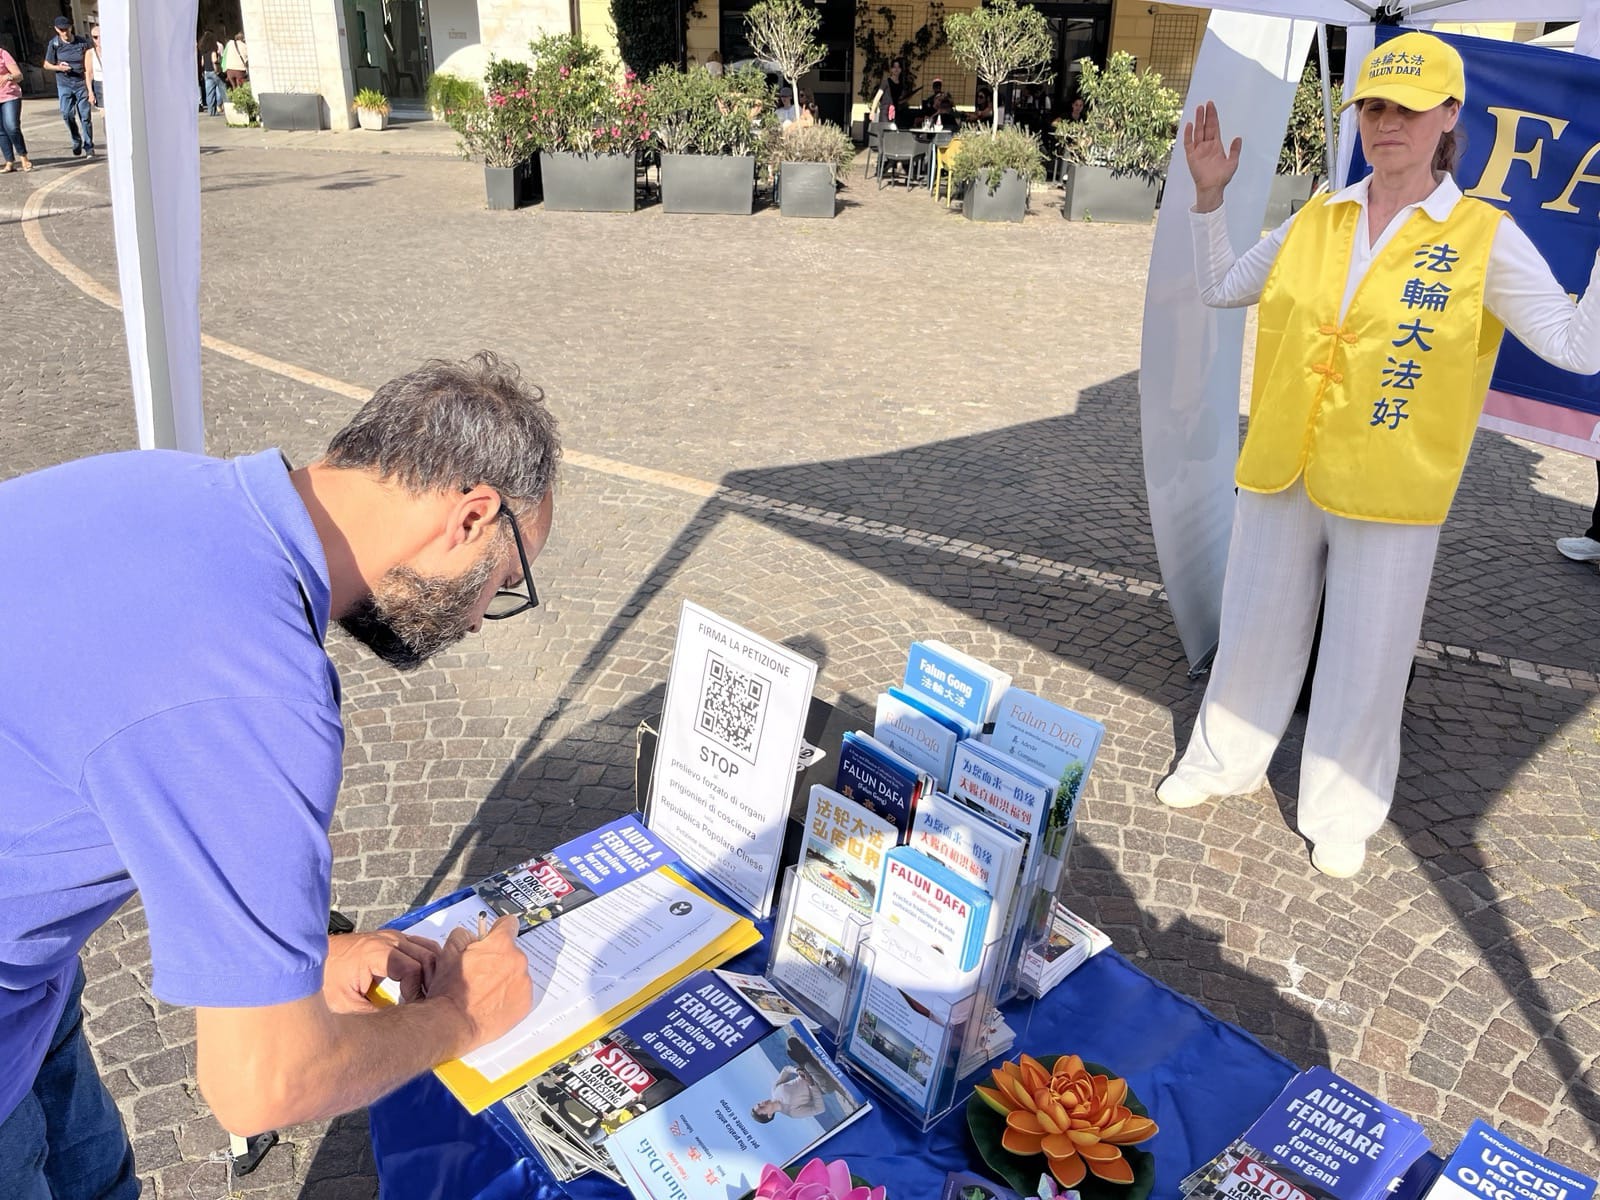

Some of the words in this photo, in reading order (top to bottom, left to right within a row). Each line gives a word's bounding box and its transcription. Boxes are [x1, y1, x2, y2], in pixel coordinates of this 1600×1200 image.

[1370, 52, 1425, 68] 法輪大法
[1395, 66, 1421, 76] DAFA
[1370, 243, 1460, 430] 法輪大法好
[698, 622, 727, 645] FIRMA
[729, 638, 740, 653] LA
[742, 645, 790, 678] PETIZIONE
[920, 658, 946, 681] Falun
[947, 673, 973, 698] Gong
[884, 711, 915, 737] Falun
[915, 728, 940, 753] Dafa
[1010, 704, 1047, 733] Falun
[1050, 722, 1083, 750] Dafa
[699, 746, 739, 778] STOP
[671, 758, 701, 782] prelievo
[702, 776, 729, 800] forzato
[730, 794, 738, 806] di
[739, 801, 766, 824] organi
[843, 759, 877, 789] FALUN
[878, 782, 904, 809] DAFA
[660, 795, 701, 829] Repubblica
[702, 823, 735, 853] Popolare
[669, 778, 707, 809] prigionieri
[708, 801, 716, 814] di
[717, 810, 757, 841] coscienza
[816, 797, 885, 849] 法轮大法
[592, 842, 604, 852] il
[596, 847, 627, 874] prelievo
[599, 830, 651, 873] FERMARE
[619, 826, 655, 854] AIUTA
[646, 850, 663, 862] A
[812, 816, 881, 870] 弘传世界
[532, 865, 569, 898] STOP
[568, 855, 581, 867] di
[575, 864, 604, 885] organi
[583, 852, 611, 876] forzato
[502, 884, 513, 896] IN
[522, 875, 553, 900] ORGAN
[890, 862, 931, 894] FALUN
[935, 886, 966, 918] DAFA
[666, 1009, 681, 1021] il
[673, 992, 744, 1048] FERMARE
[696, 984, 743, 1019] AIUTA
[736, 1015, 756, 1030] A
[642, 1032, 659, 1044] di
[653, 1041, 690, 1069] organi
[660, 1024, 697, 1055] forzato
[673, 1018, 716, 1050] prelievo
[578, 1069, 621, 1104] HARVESTING
[590, 1063, 630, 1097] ORGAN
[600, 1047, 649, 1087] STOP
[565, 1075, 580, 1091] IN
[578, 1085, 611, 1113] CHINA
[1305, 1088, 1367, 1129] AIUTA
[1367, 1122, 1387, 1139] A
[1286, 1098, 1384, 1160] FERMARE
[1287, 1117, 1300, 1131] il
[1299, 1126, 1359, 1165] prelievo
[637, 1138, 664, 1173] Dafa
[1273, 1143, 1291, 1158] di
[1290, 1155, 1341, 1187] organi
[1288, 1135, 1341, 1171] forzato
[1479, 1131, 1520, 1159] PRATICANTI
[1520, 1155, 1535, 1168] DEL
[1535, 1164, 1560, 1179] FALUN
[1560, 1175, 1586, 1190] GONG
[1241, 1162, 1306, 1200] STOP
[1480, 1148, 1568, 1200] UCCISI
[1486, 1168, 1508, 1185] PER
